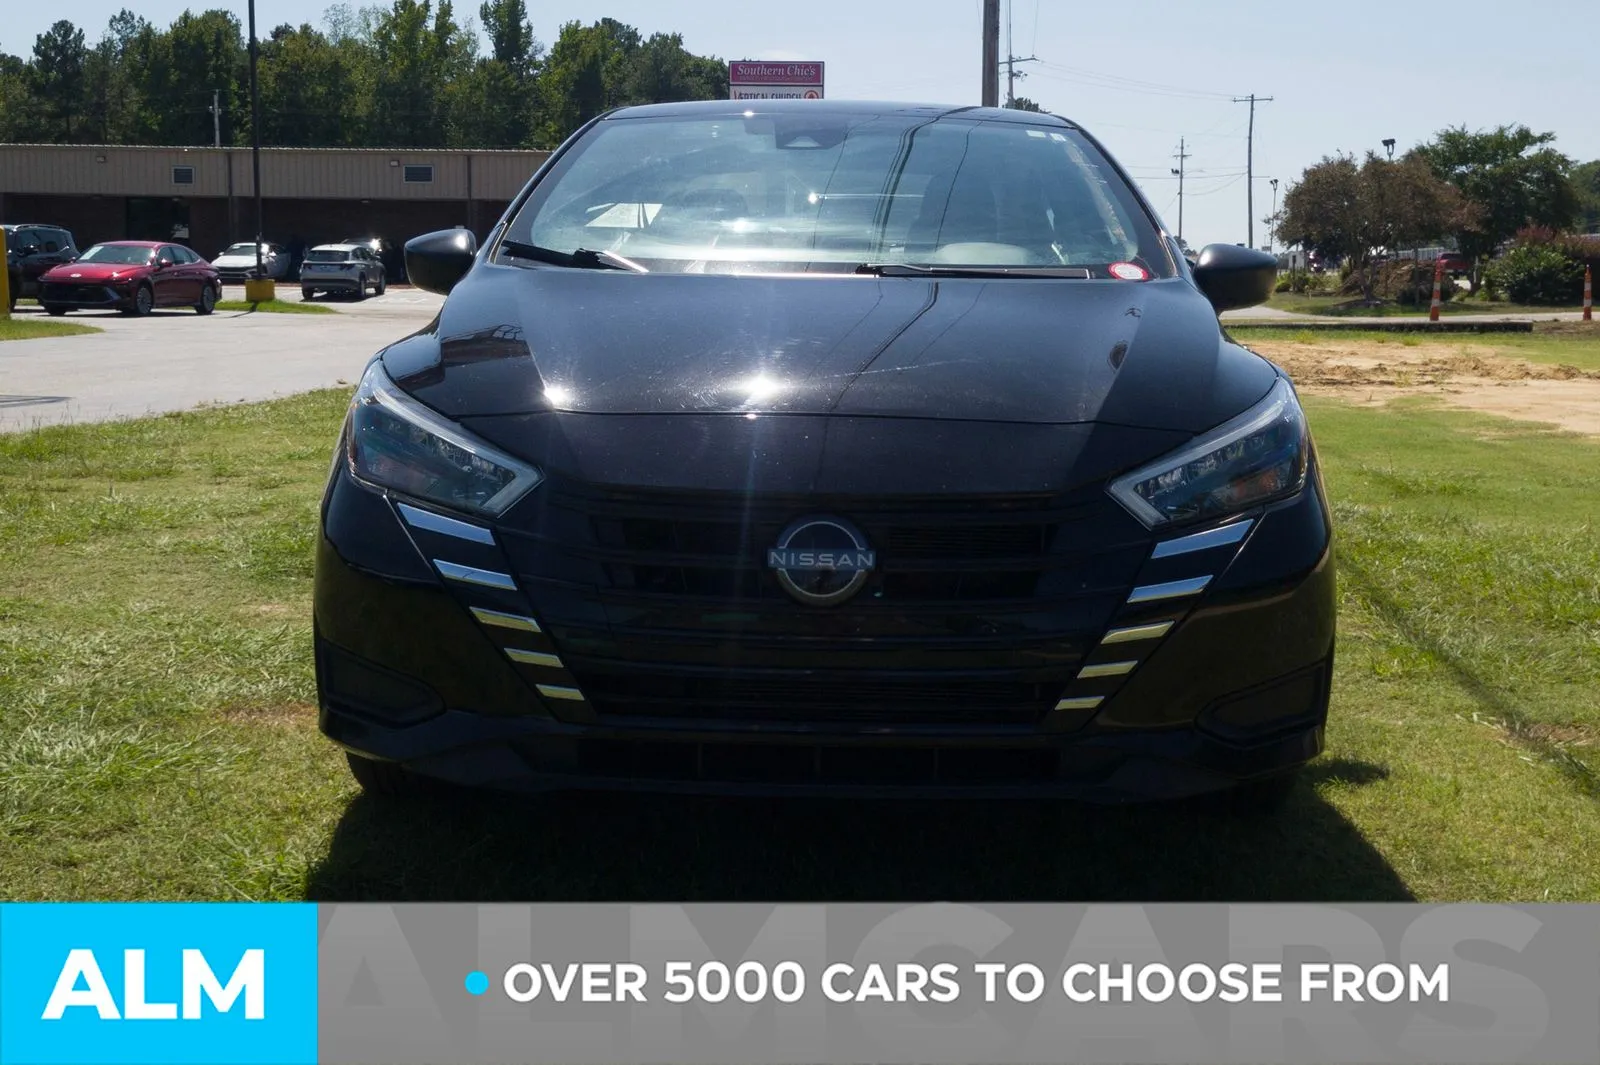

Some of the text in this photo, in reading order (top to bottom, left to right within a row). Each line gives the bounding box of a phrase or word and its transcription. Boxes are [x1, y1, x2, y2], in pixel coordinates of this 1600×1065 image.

[737, 64, 816, 76] Southern Chic's
[769, 551, 873, 567] NISSAN
